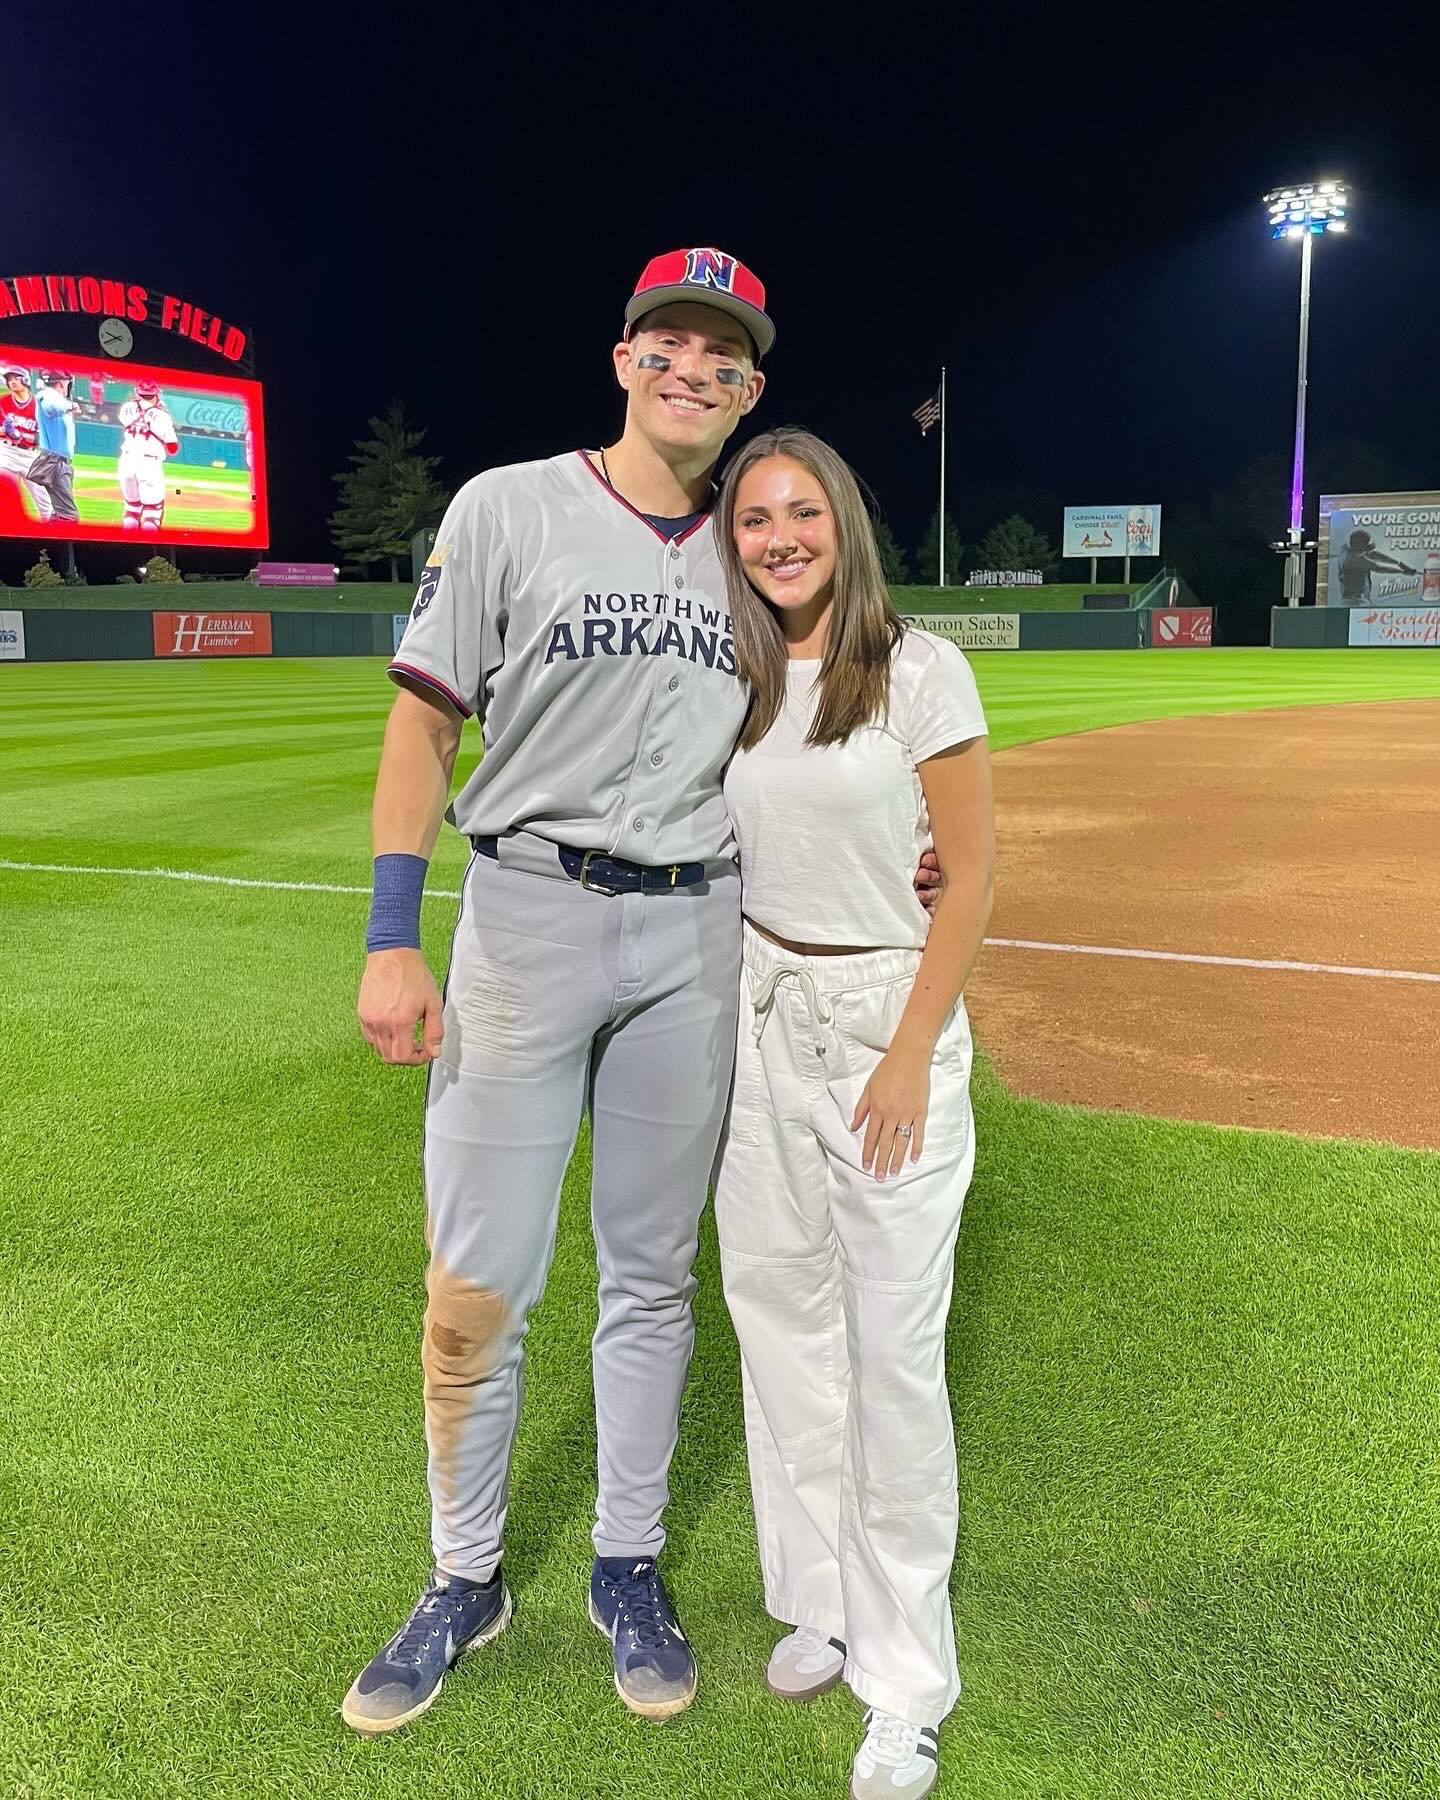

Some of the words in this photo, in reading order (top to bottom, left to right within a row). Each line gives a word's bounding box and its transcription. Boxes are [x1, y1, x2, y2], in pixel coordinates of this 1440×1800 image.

[680, 247, 739, 294] N
[162, 295, 246, 361] FIELD
[1352, 512, 1405, 526] YOU'RE
[1385, 525, 1421, 537] NEED
[1424, 525, 1440, 536] M
[1390, 538, 1420, 550] FOR
[917, 617, 962, 631] Aaron
[968, 616, 1014, 631] Sachs
[171, 615, 252, 652] HERRMAN
[203, 635, 239, 646] Lumber
[946, 634, 996, 646] ociates,
[544, 617, 737, 677] ARKANS
